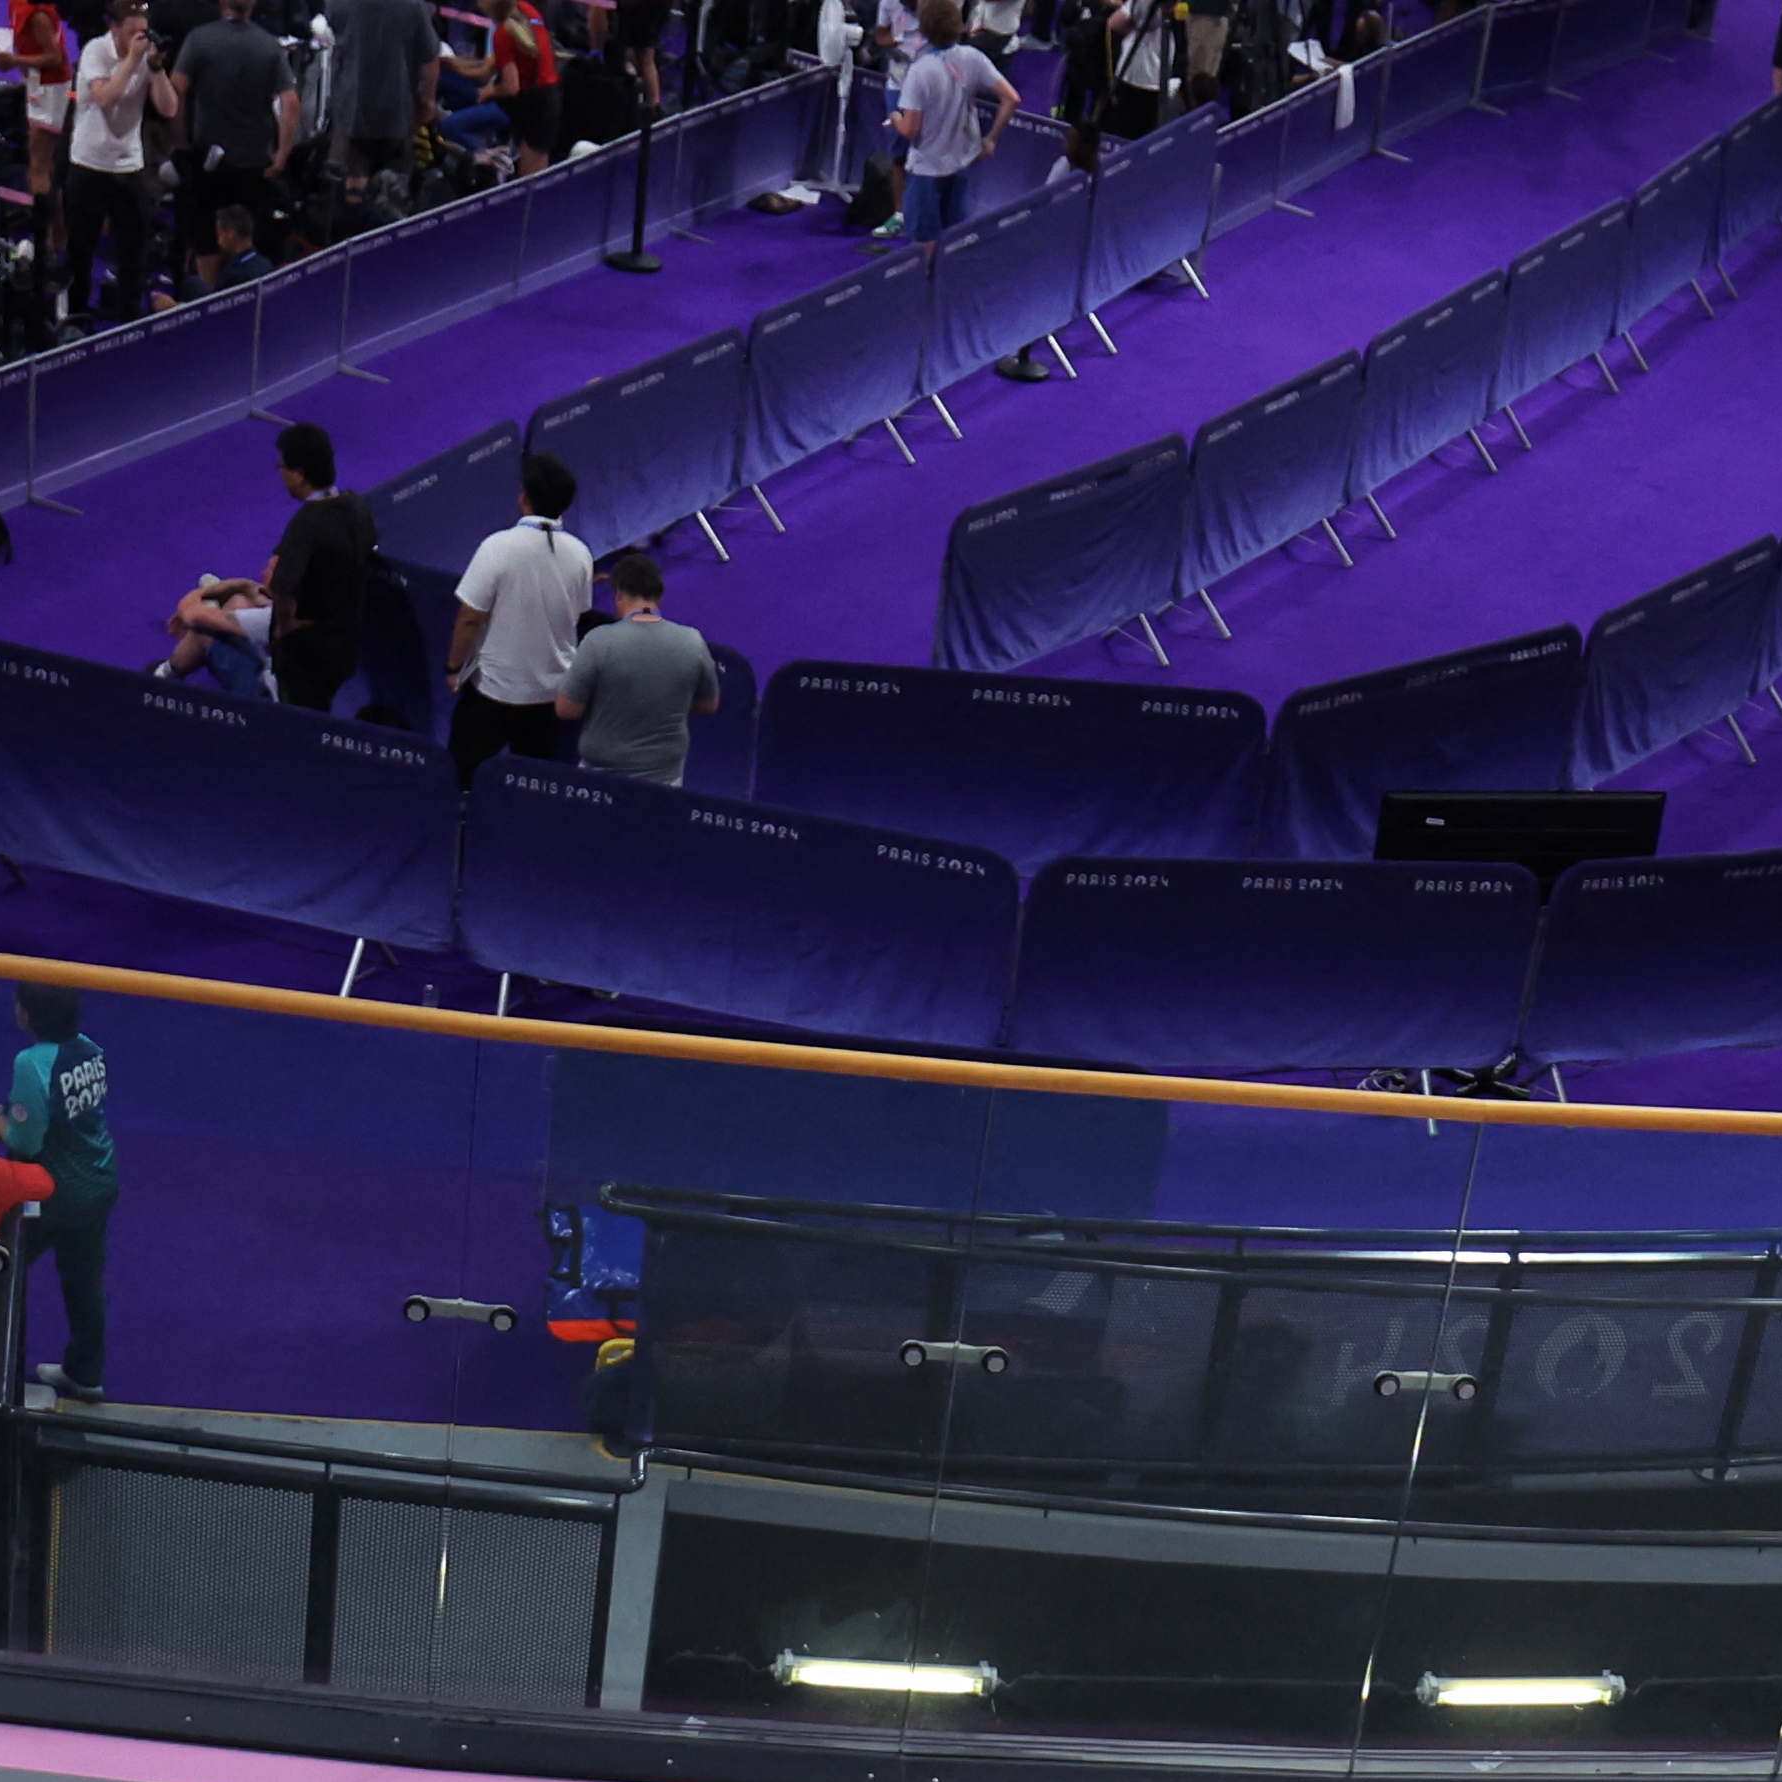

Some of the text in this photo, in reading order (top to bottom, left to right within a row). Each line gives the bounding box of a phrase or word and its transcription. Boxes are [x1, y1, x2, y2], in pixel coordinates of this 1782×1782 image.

[23, 664, 70, 687] 2024
[800, 676, 900, 694] PARIS 2024
[972, 688, 1071, 707] PARIS 2024
[143, 692, 247, 727] PARIS 2024
[1141, 700, 1239, 719] PARIS 2024
[321, 731, 426, 766] PARIS 2024
[505, 773, 613, 806] PARIS 2024
[691, 809, 799, 841] PARIS 2024
[877, 844, 986, 878] PARIS 2024
[1066, 872, 1170, 888] PARIS 2024
[1242, 877, 1343, 892] PARIS 2024
[1415, 878, 1513, 894] PARIS 2024
